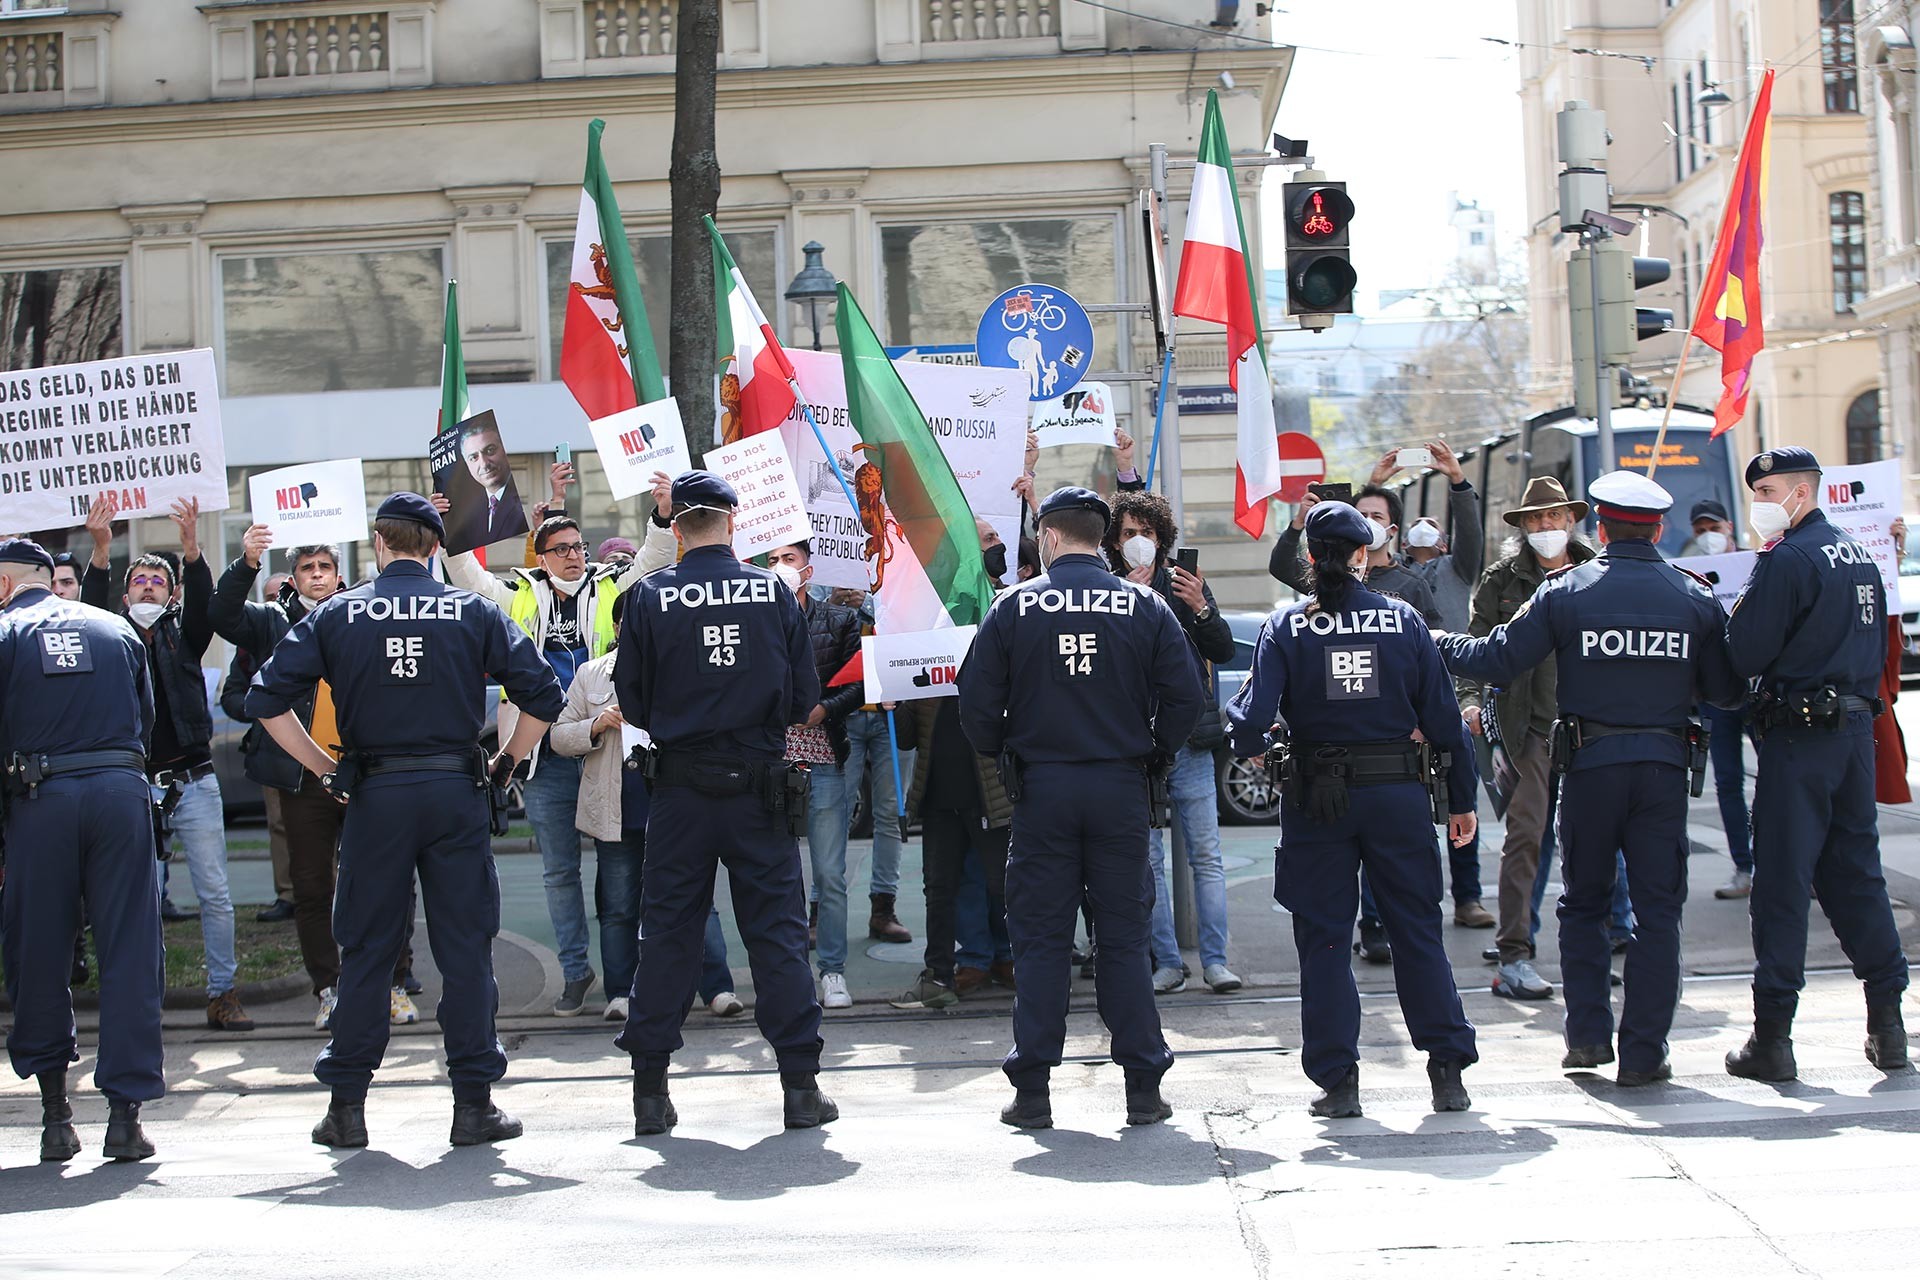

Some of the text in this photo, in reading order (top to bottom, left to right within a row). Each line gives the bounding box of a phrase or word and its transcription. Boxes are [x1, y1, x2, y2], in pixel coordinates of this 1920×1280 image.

[0, 362, 181, 403] DAS GELD, DAS DEM
[1177, 394, 1222, 406] ärntner
[0, 391, 198, 433] REGIME IN DIE HÄNDE
[927, 416, 953, 437] AND
[956, 418, 996, 440] RUSSIA
[1, 423, 192, 464] KOMMT VERLÄNGERT
[447, 439, 457, 449] OF
[618, 429, 646, 456] NO
[722, 442, 767, 465] Do not
[431, 449, 457, 473] IRAN
[635, 450, 657, 464] ISLAMIC
[656, 445, 675, 458] REPUBLIC
[2, 452, 202, 494] DIE UNTERDRÜCKUNG
[720, 455, 783, 482] egotiate
[734, 473, 785, 496] ith the
[1828, 484, 1849, 505] NO
[70, 494, 91, 517] IM
[275, 486, 301, 511] NO
[279, 507, 342, 521] TO ISLAMIC REPUBLIC
[734, 503, 799, 532] terrorist
[749, 523, 793, 545] regime
[818, 537, 864, 561] REPUBLIC
[1820, 540, 1873, 569] POLIZ
[660, 578, 776, 612] POLIZEI
[1019, 588, 1136, 617] POLIZEI
[1856, 584, 1875, 605] BE
[347, 596, 462, 624] POLIZEI
[1861, 604, 1874, 625] 43
[1289, 609, 1403, 638] POLIZEI
[42, 631, 83, 652] BE
[385, 636, 424, 658] BE
[702, 624, 741, 647] BE
[1058, 633, 1098, 655] BE
[1581, 629, 1690, 659] POLIZEI
[56, 654, 78, 668] 43
[708, 645, 736, 667] 43
[889, 655, 955, 668] TO ISLAMIC REPUBLIC
[1065, 655, 1092, 676] 14
[1331, 650, 1373, 676] BE
[390, 658, 418, 678] 43
[931, 665, 956, 685] NO
[1342, 678, 1365, 693] 14
